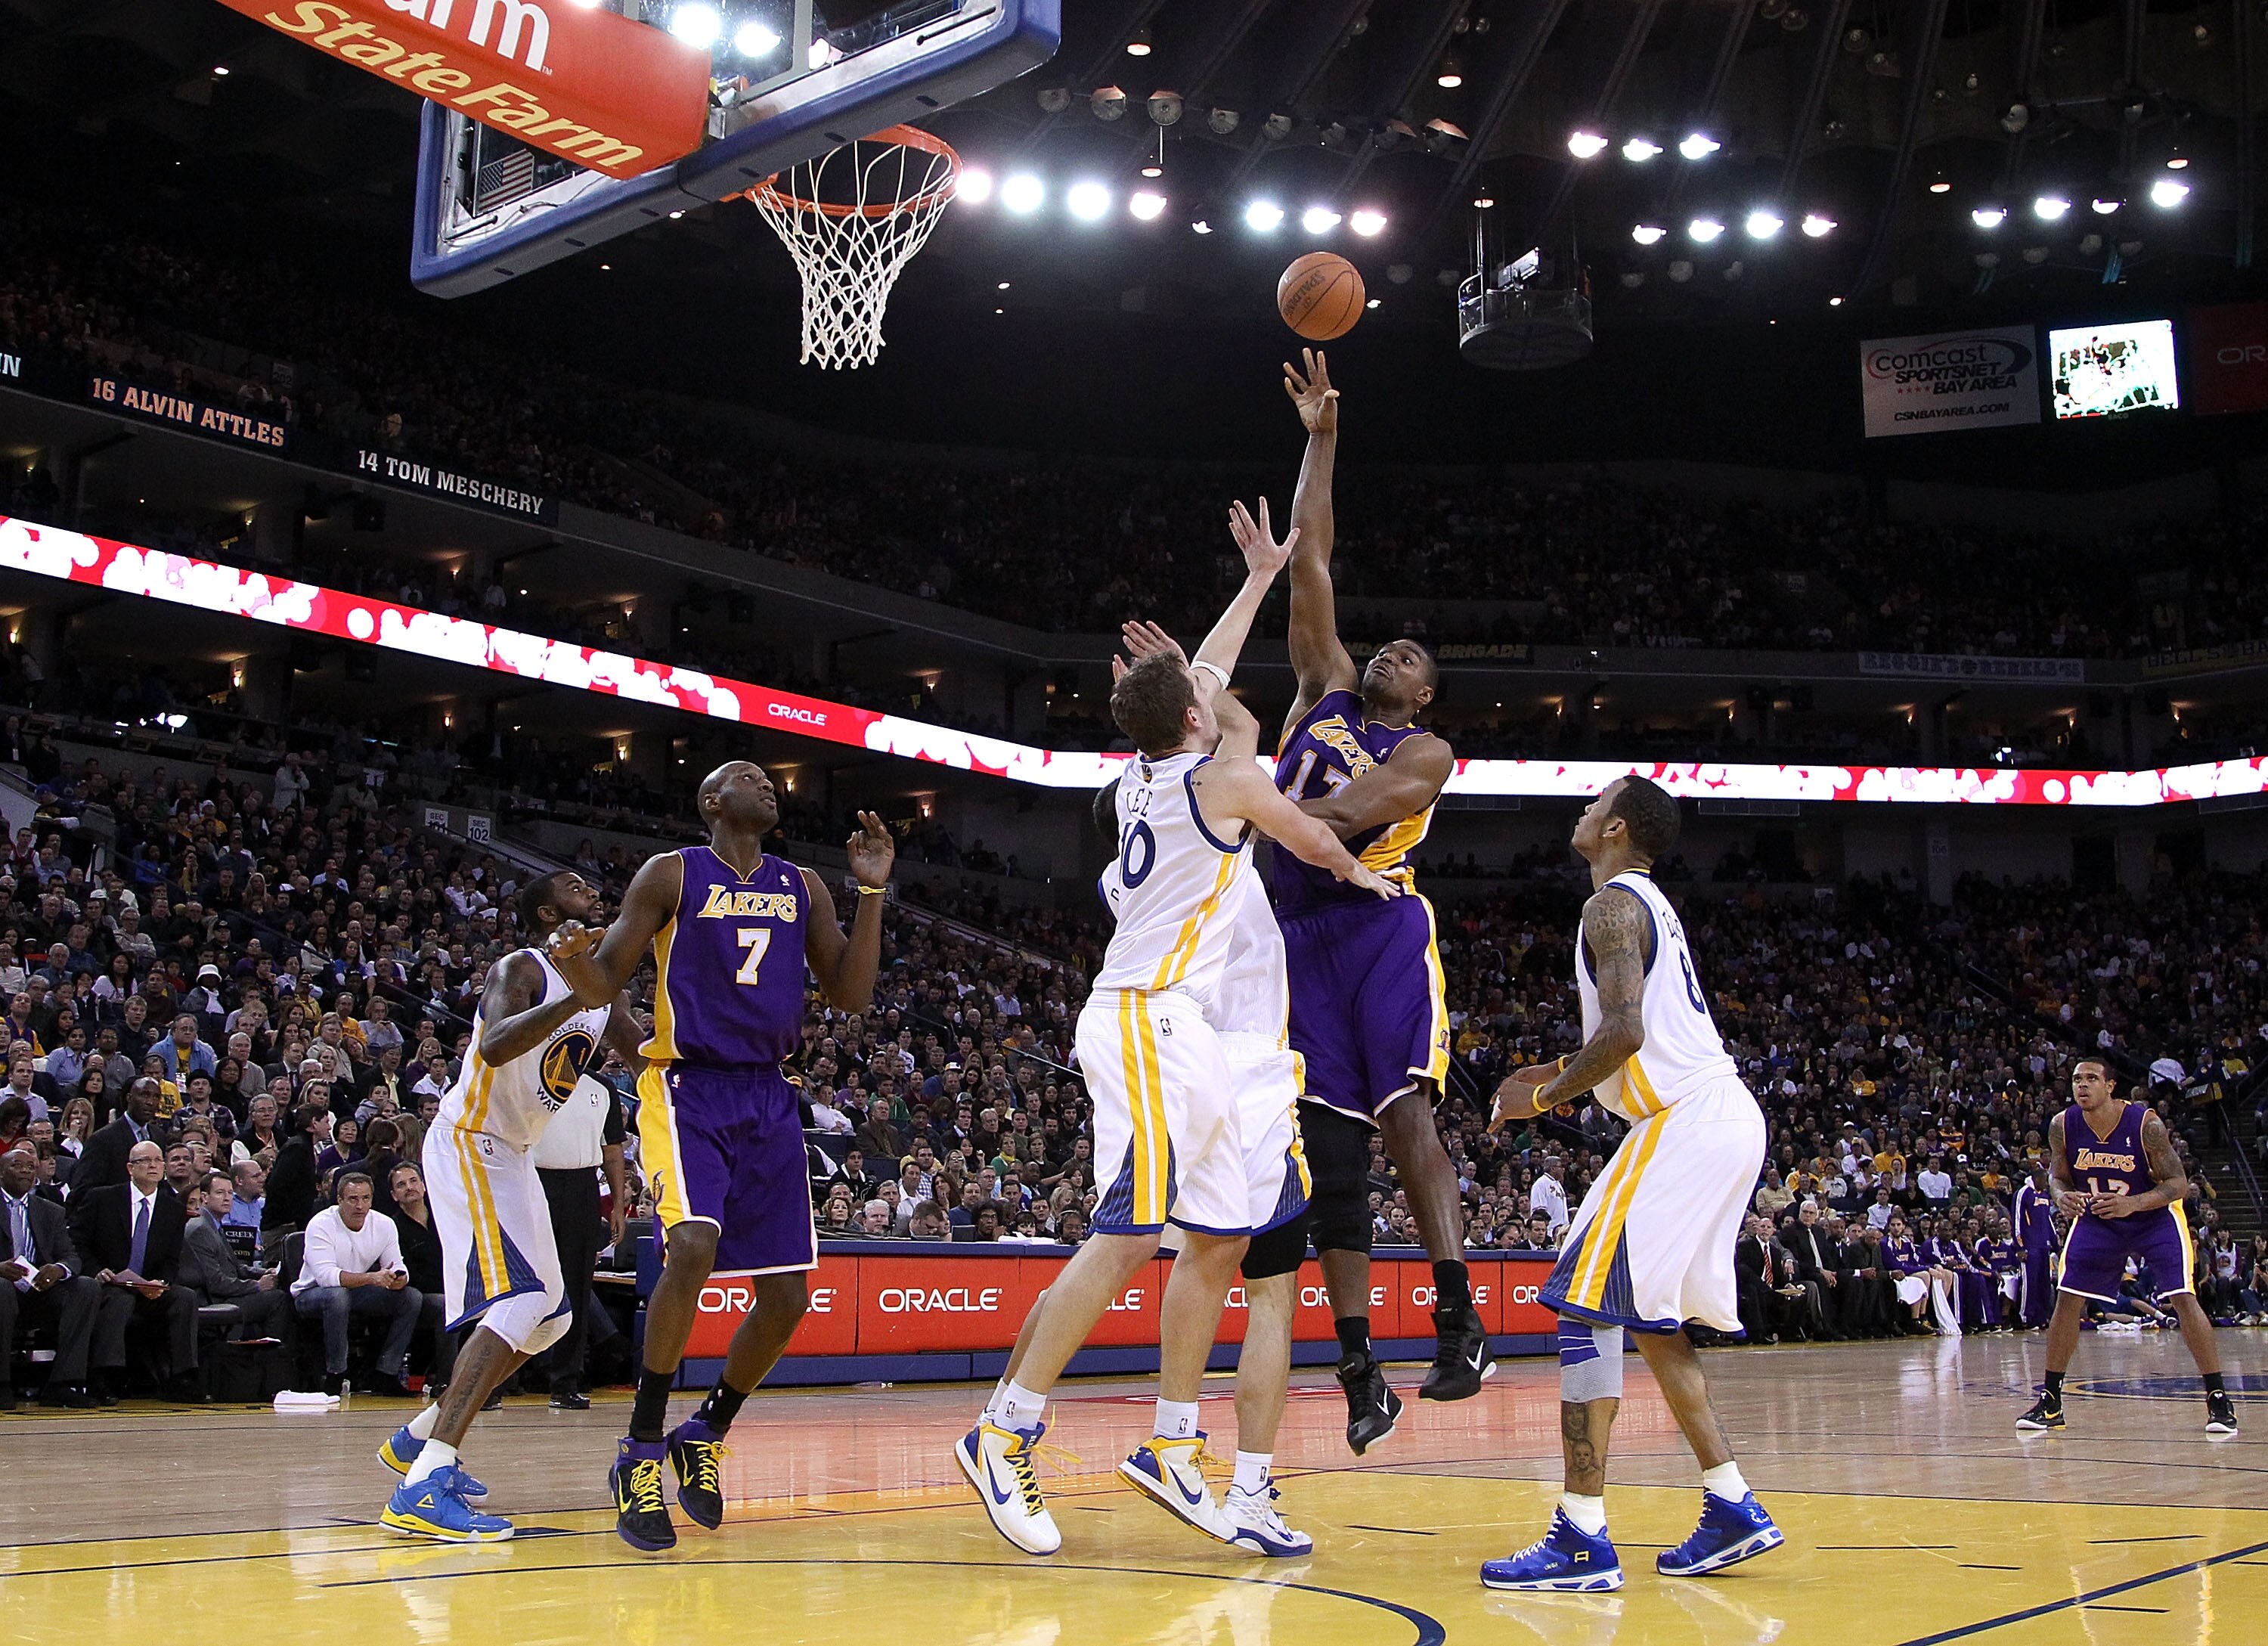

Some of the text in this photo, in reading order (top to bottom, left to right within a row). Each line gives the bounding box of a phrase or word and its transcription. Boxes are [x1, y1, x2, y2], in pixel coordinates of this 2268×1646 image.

[265, 1, 643, 166] State Farm
[1895, 362, 2001, 384] SPORTSNET
[1933, 375, 2017, 395] BAY AREA
[91, 377, 285, 448] 16 ALVIN ATTLES
[1894, 403, 2009, 422] CSNBAYAREA.COM
[358, 449, 544, 516] 14 TOM MESCHERY
[768, 703, 825, 726] ORACLE
[469, 827, 489, 842] 102
[472, 820, 486, 828] SEC
[696, 884, 798, 922] LAKERS
[736, 928, 771, 984] 7
[2073, 1148, 2136, 1172] LAKERS
[878, 1288, 998, 1313] ORACLE
